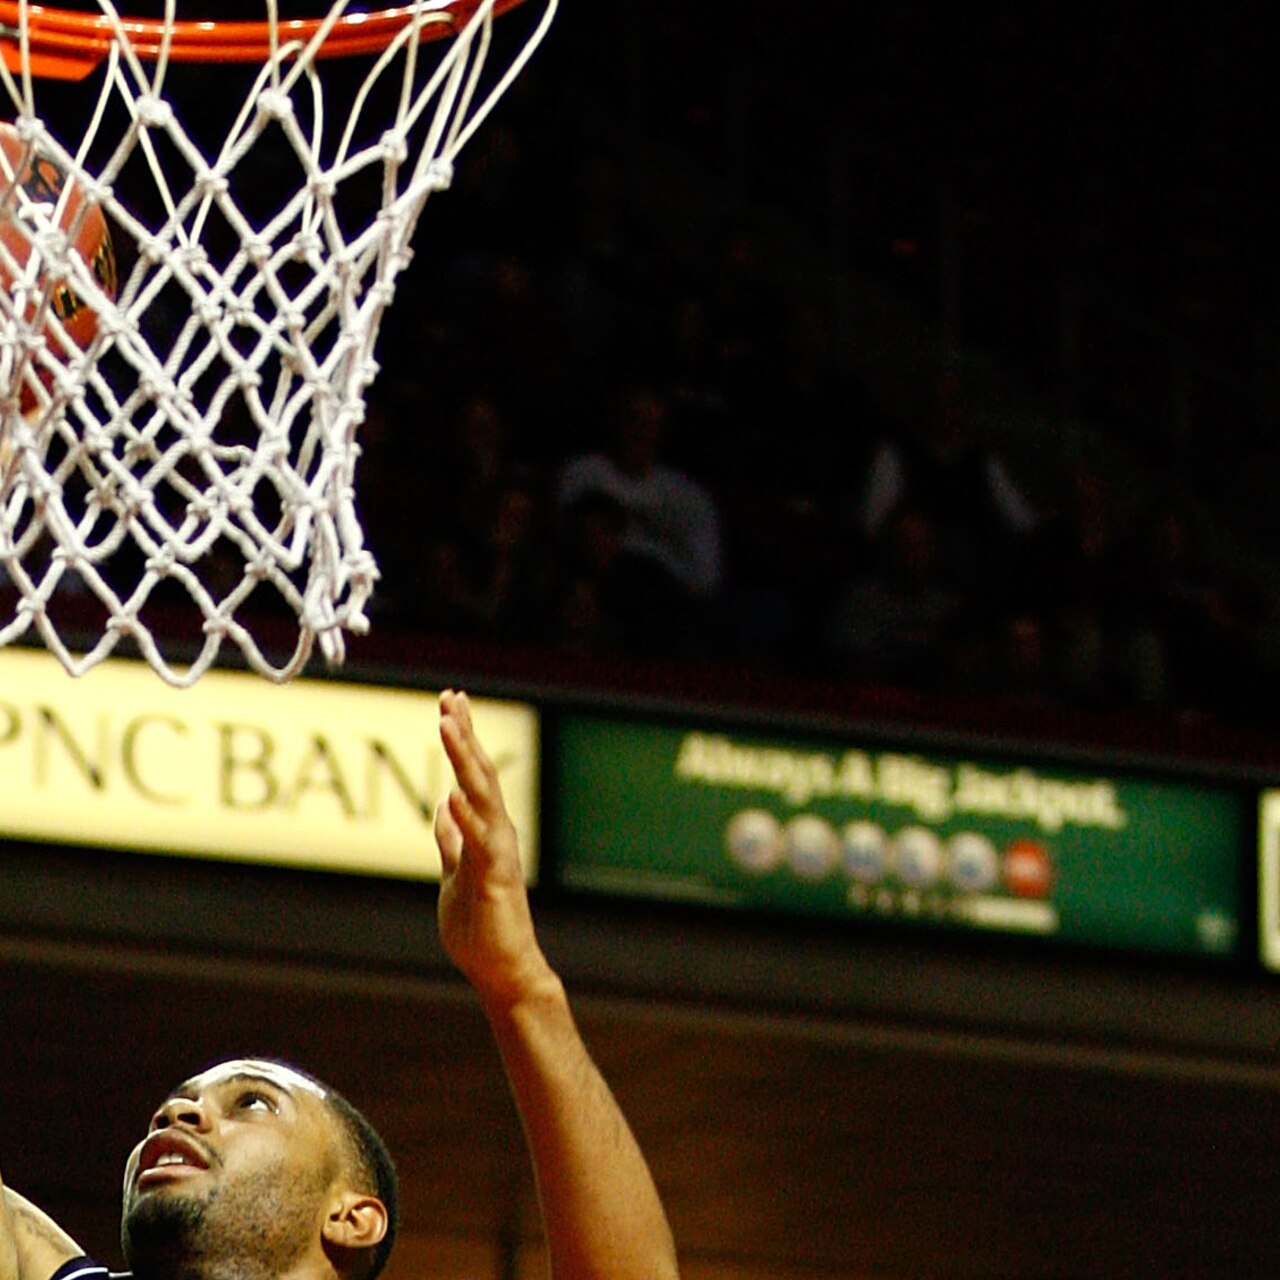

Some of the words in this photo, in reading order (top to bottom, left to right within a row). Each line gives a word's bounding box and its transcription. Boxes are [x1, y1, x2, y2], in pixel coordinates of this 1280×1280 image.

[220, 722, 516, 825] BAN
[675, 731, 834, 806] Always
[840, 748, 874, 797] A
